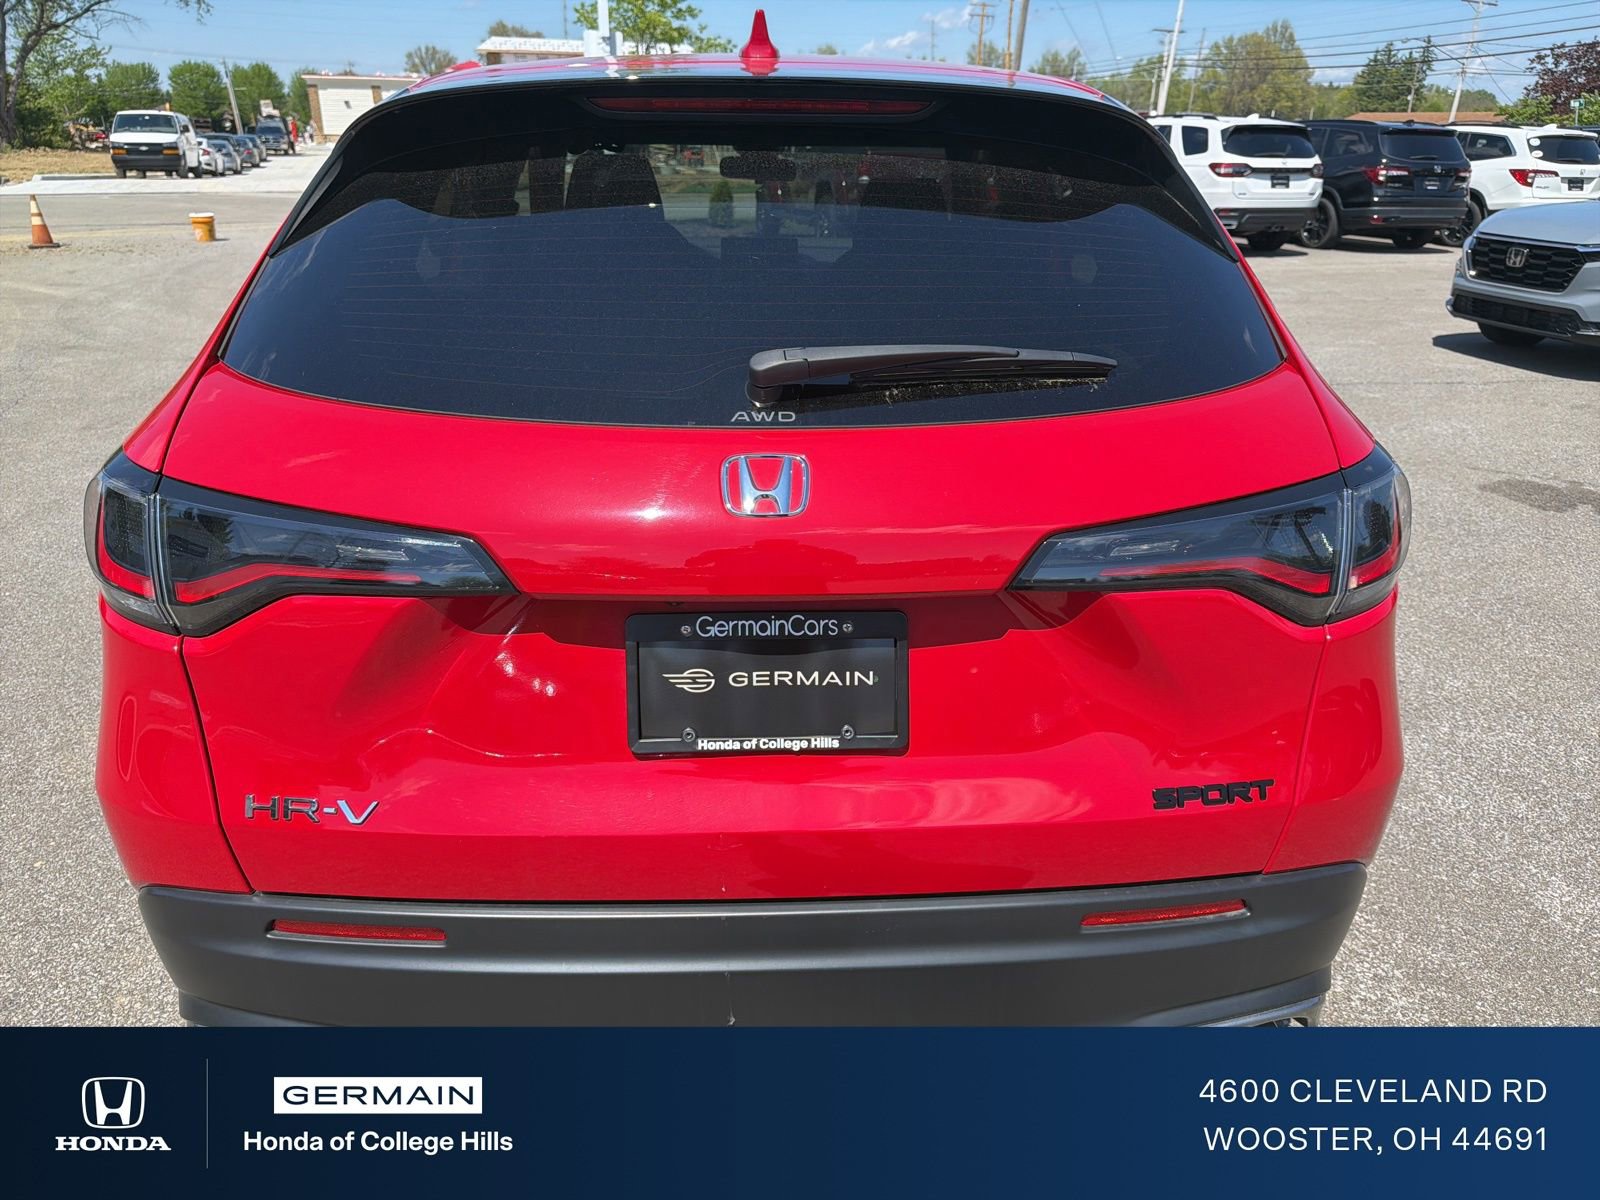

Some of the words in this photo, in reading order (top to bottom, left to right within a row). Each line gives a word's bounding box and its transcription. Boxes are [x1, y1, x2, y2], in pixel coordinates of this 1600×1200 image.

[731, 411, 796, 422] AWD
[696, 614, 838, 637] GermainCars
[728, 670, 874, 687] GERMAIN
[698, 739, 741, 750] Honda
[743, 738, 757, 749] of
[759, 738, 808, 751] College
[811, 737, 840, 748] Hills
[1152, 779, 1275, 810] SPORT
[244, 793, 379, 825] HR-V
